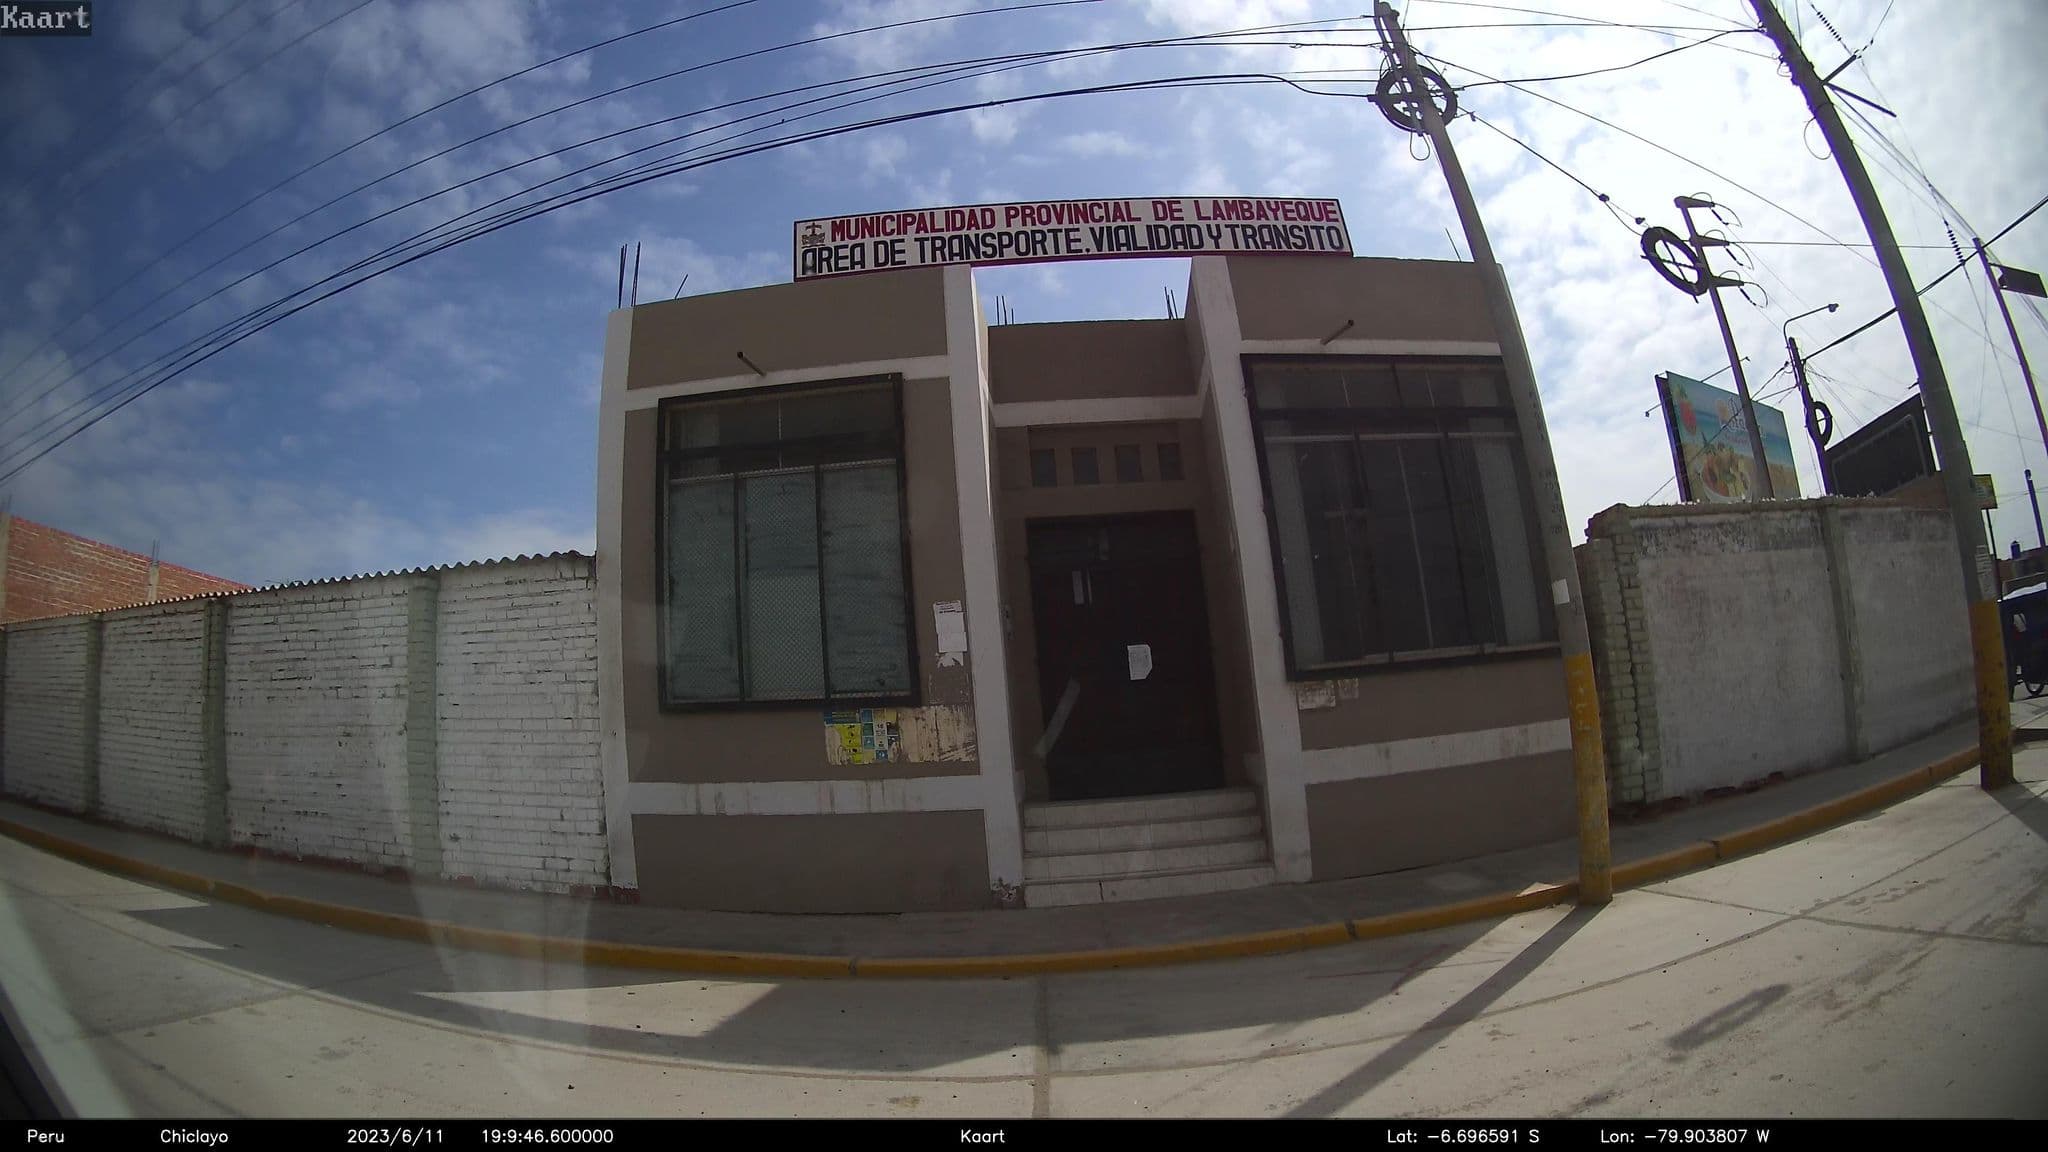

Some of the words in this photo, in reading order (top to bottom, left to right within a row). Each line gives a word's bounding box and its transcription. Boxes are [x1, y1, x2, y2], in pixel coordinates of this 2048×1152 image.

[831, 207, 996, 242] MUNICIPALIDAD
[1005, 201, 1142, 228] PROVINCIAL
[1152, 200, 1185, 222] DE
[1193, 200, 1340, 223] LAMBAYEQUE
[801, 242, 866, 276] AREA
[873, 238, 907, 267] DE
[1208, 224, 1222, 249] Y
[1225, 224, 1345, 251] TRANSITO
